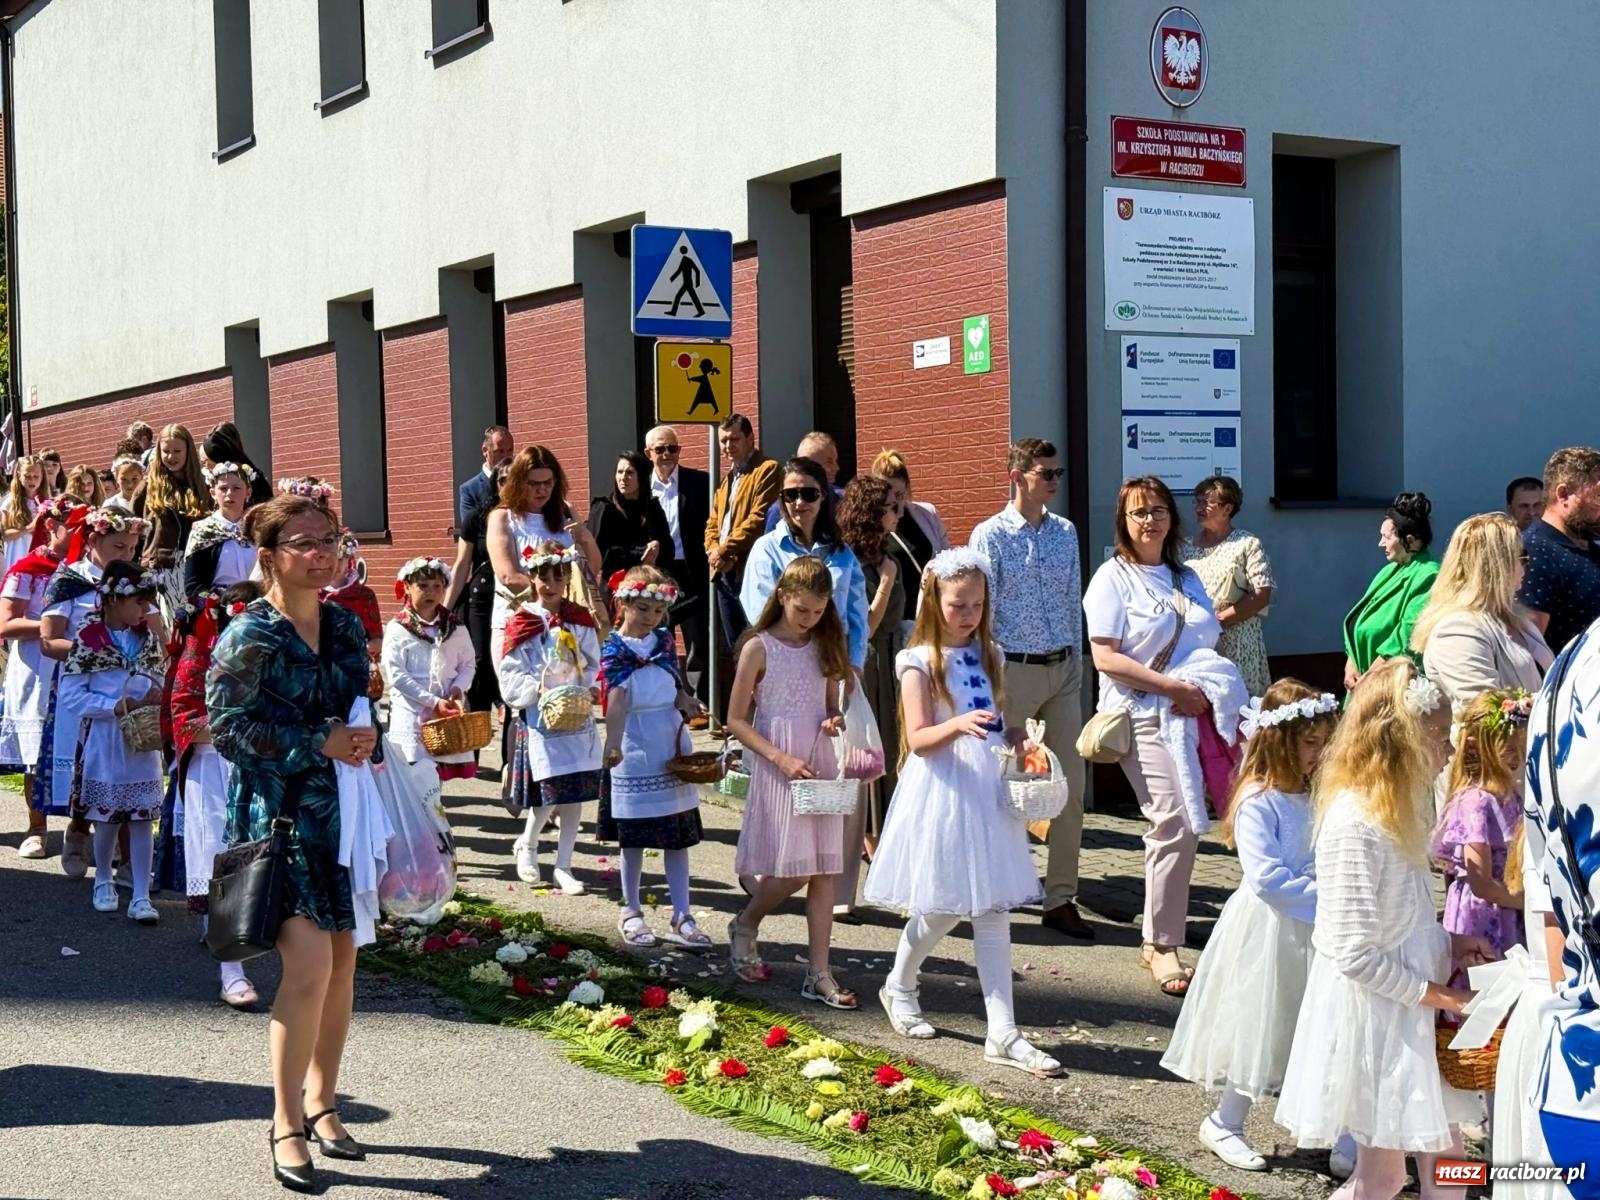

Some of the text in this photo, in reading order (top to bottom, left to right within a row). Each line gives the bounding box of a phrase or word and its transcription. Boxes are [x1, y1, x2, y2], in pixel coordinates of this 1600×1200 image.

[1137, 126, 1226, 146] SZKOŁA PODSTAWOWA NR 3
[1117, 141, 1243, 163] IM. KRZYSZTOFA KAMILA BACZYŃSKIEGO
[1160, 161, 1204, 176] W RACIBORZU
[1139, 206, 1222, 220] URZĄD MIASTA RACIBÓRZ
[968, 350, 984, 362] AED
